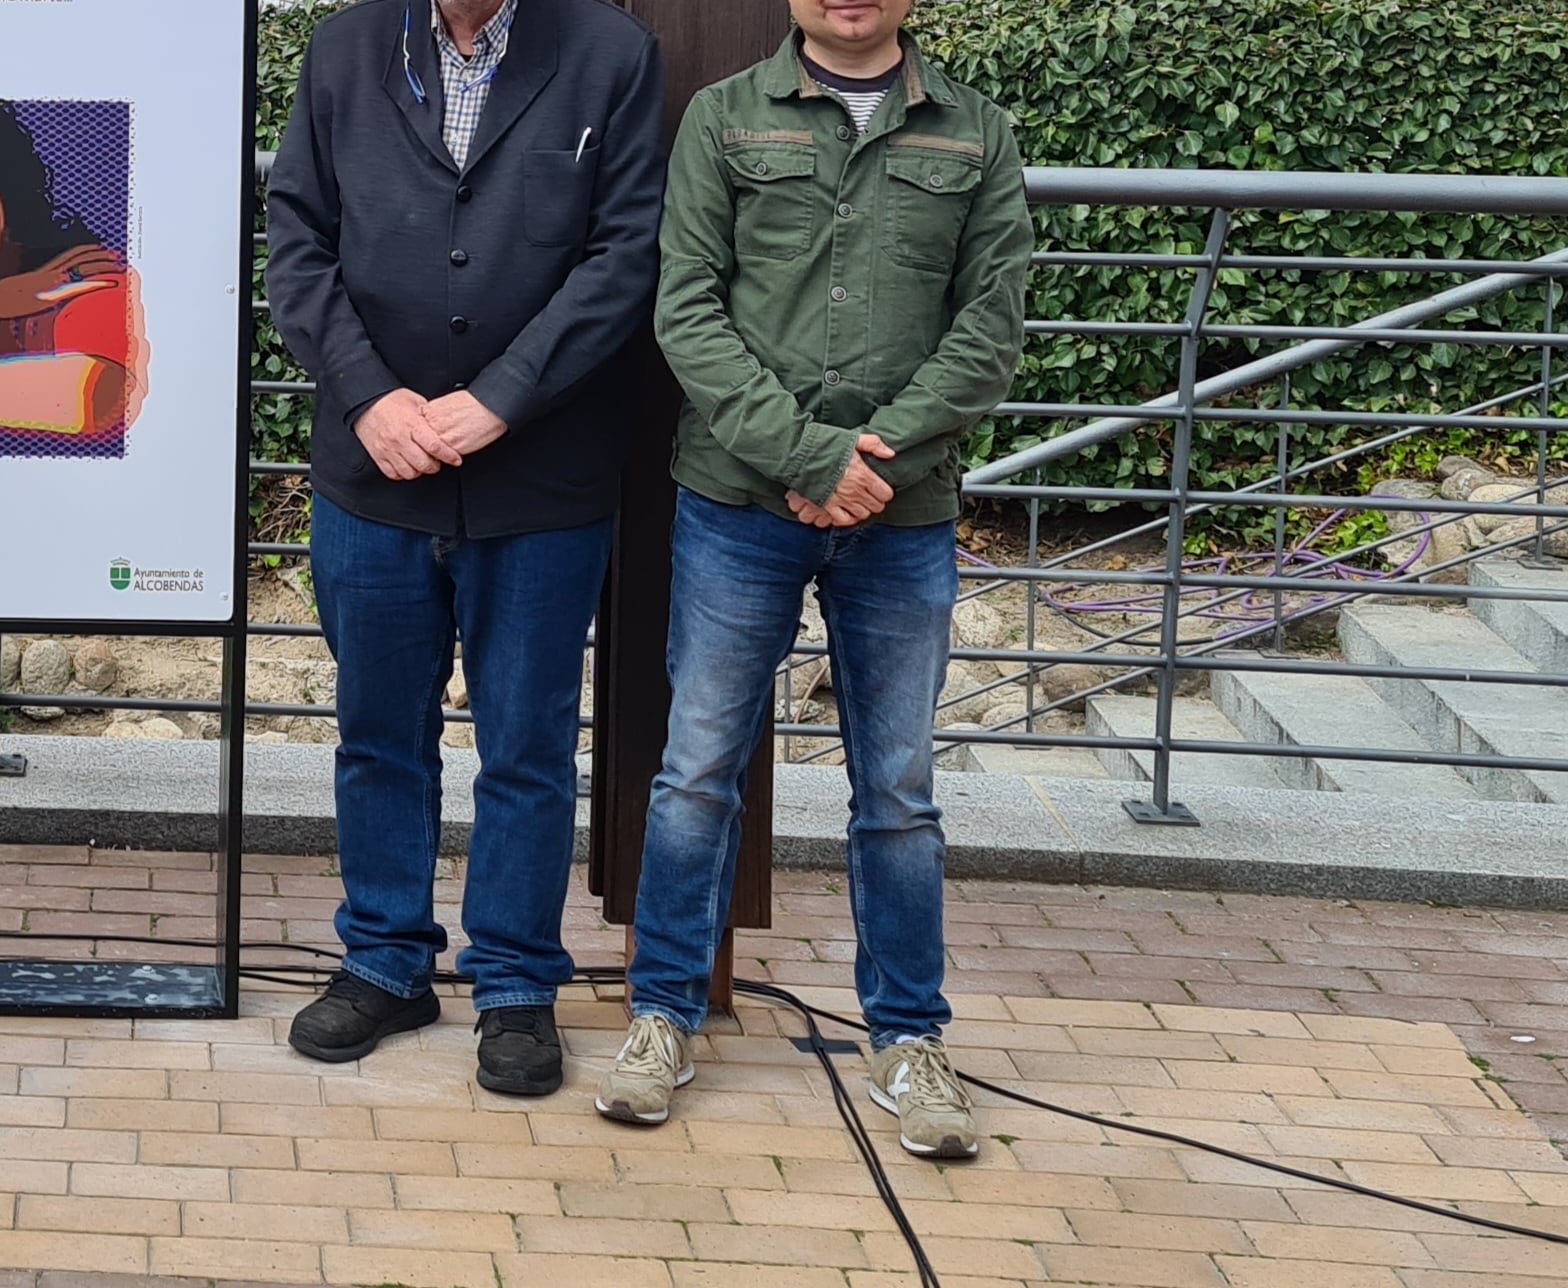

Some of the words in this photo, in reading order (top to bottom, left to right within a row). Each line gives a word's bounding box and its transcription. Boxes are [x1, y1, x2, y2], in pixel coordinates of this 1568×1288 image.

[134, 567, 190, 580] Ayuntamiento
[193, 568, 204, 578] de
[133, 579, 204, 592] ALCOBENDAS
